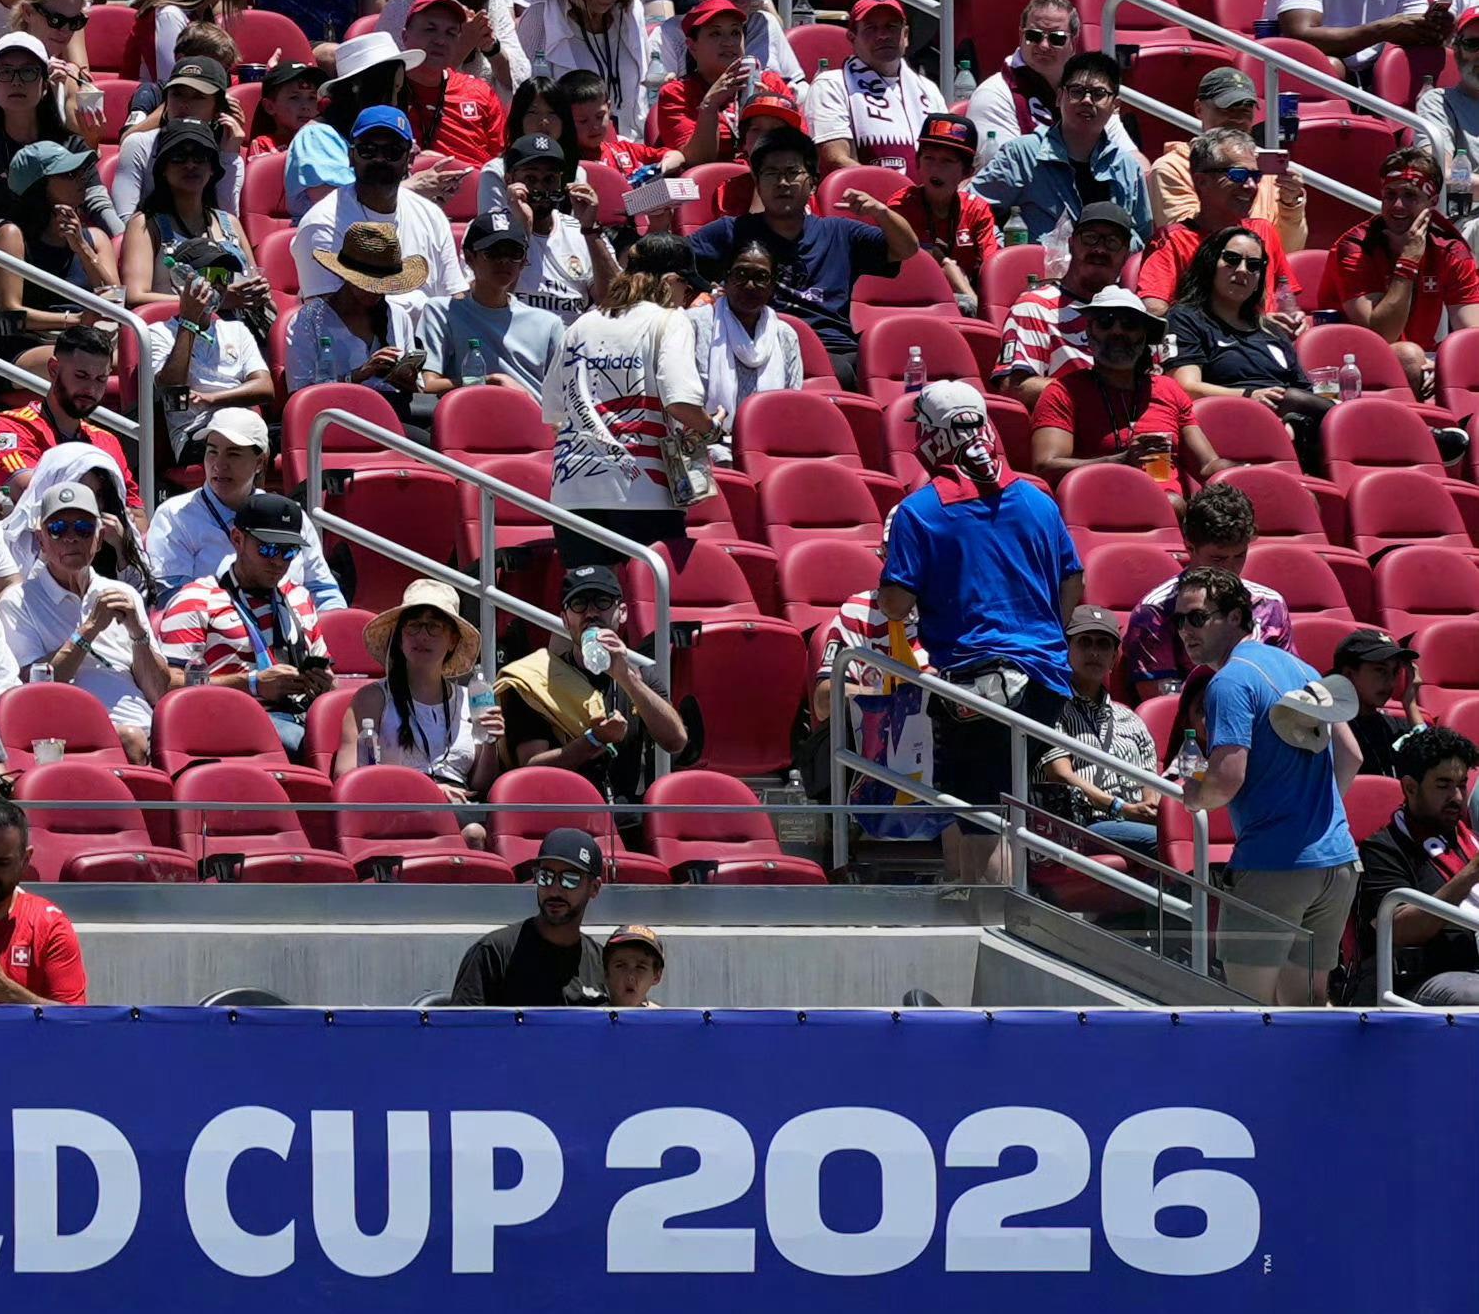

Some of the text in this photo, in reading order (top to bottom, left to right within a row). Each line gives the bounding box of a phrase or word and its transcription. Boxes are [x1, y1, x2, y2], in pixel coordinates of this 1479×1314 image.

[586, 353, 643, 371] adidas
[184, 1104, 564, 1278] CUP
[604, 1105, 1262, 1277] 2026
